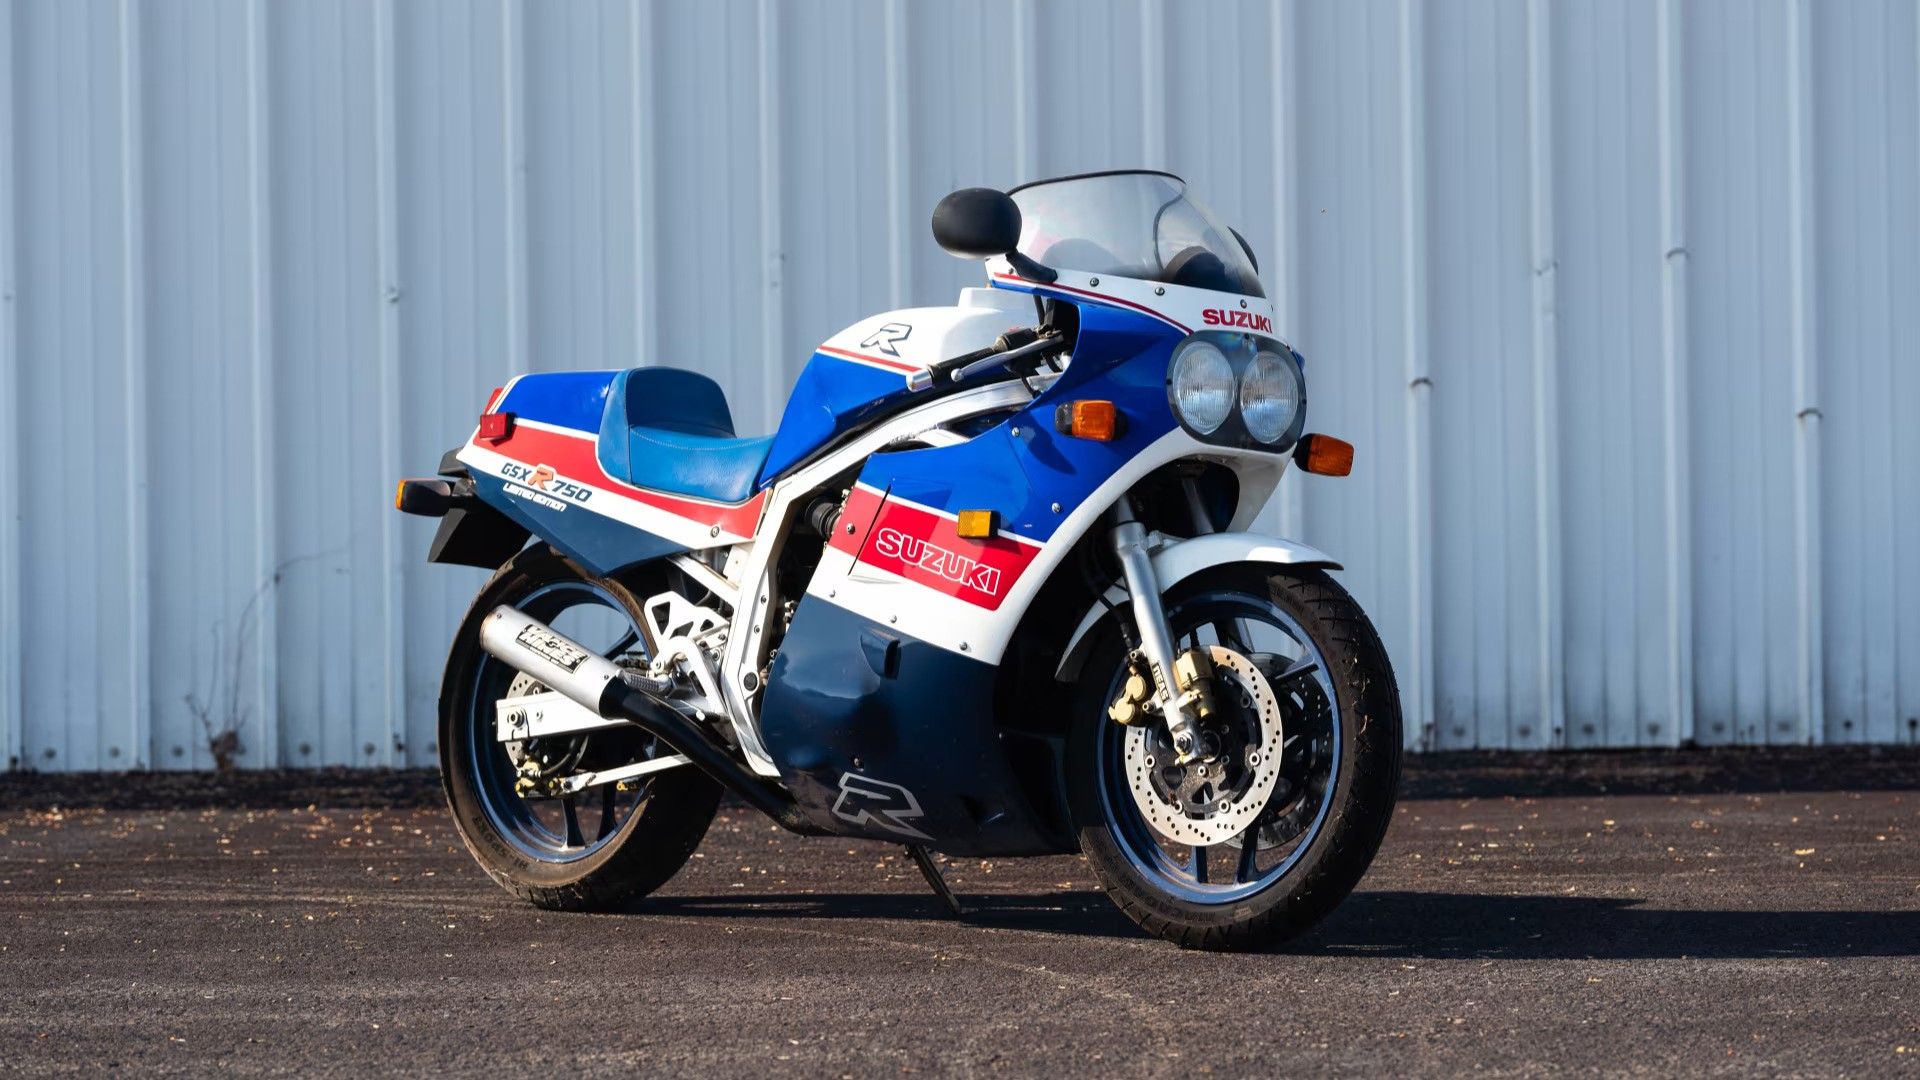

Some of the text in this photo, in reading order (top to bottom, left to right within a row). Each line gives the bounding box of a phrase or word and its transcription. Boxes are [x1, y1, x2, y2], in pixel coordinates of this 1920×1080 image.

[860, 322, 912, 358] R
[1202, 308, 1272, 334] SUZUKI
[876, 528, 1000, 596] SUZUKI
[832, 772, 937, 841] R
